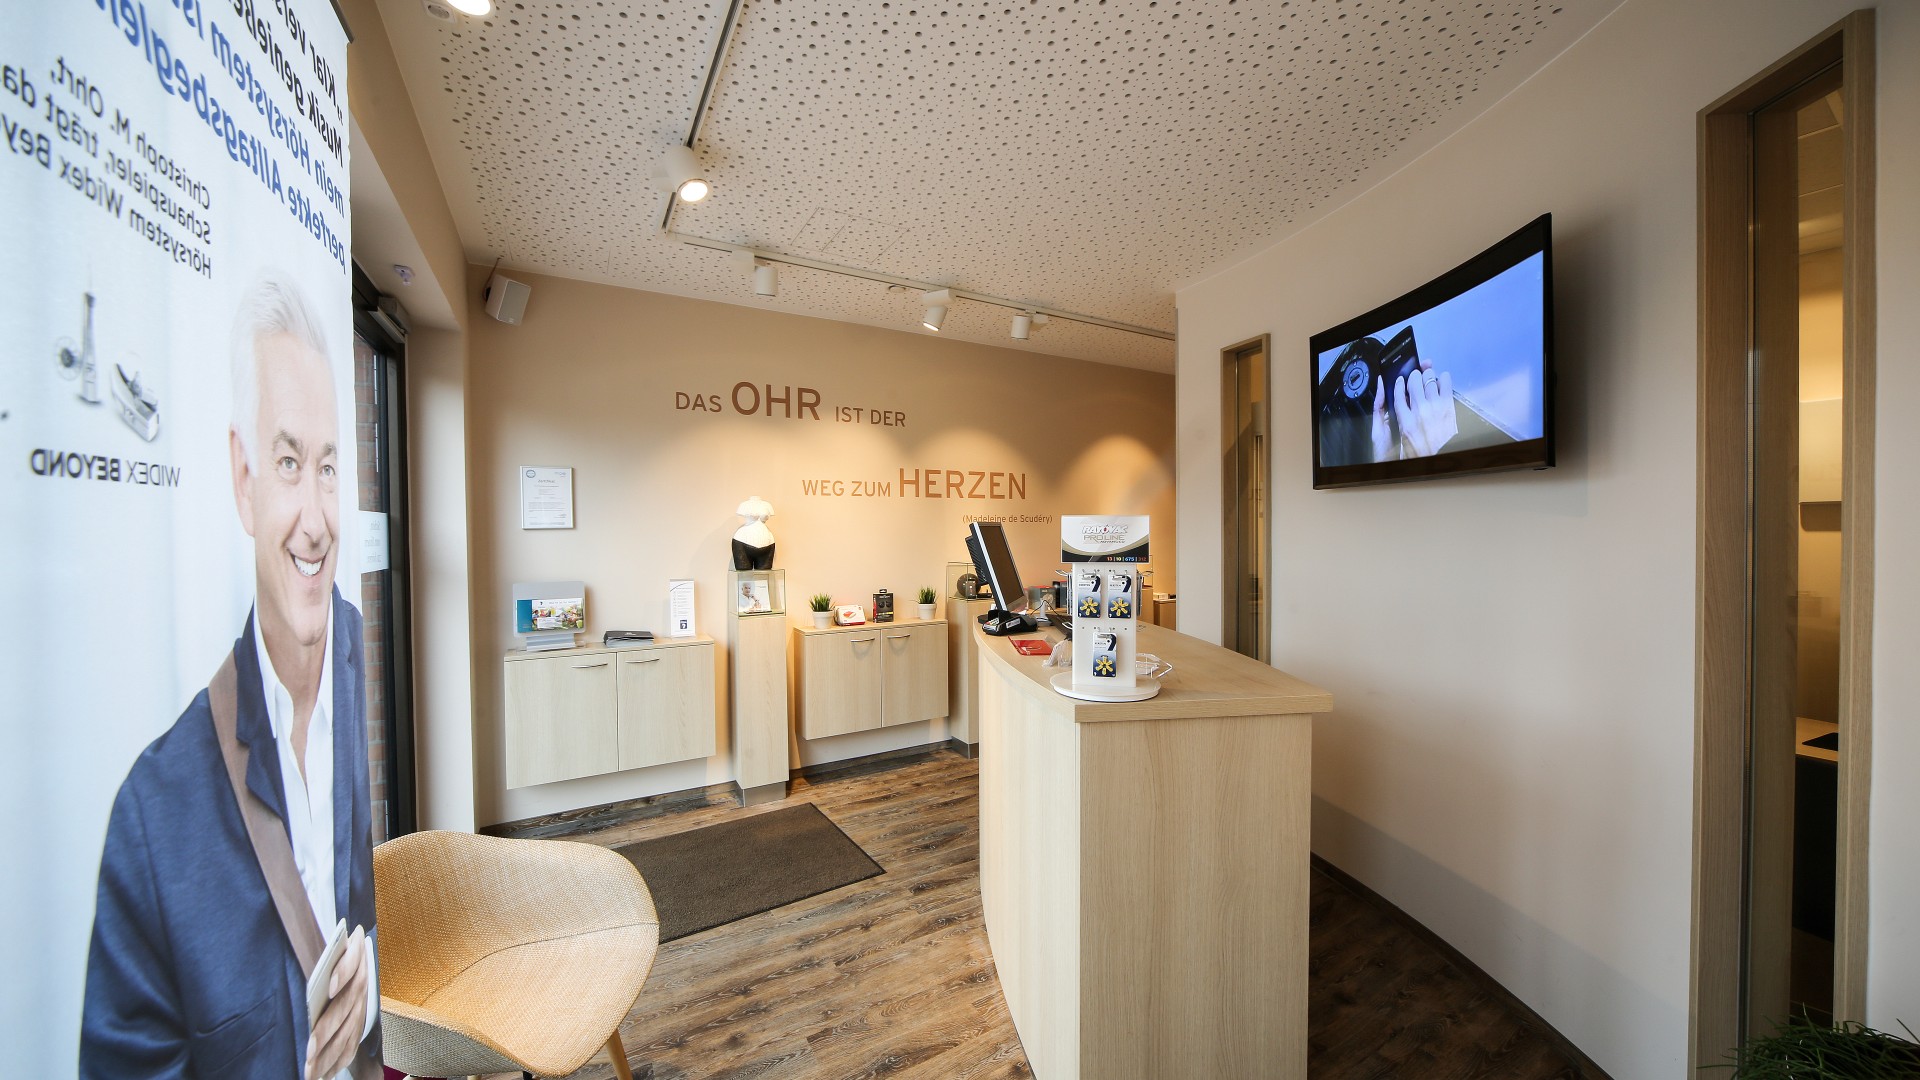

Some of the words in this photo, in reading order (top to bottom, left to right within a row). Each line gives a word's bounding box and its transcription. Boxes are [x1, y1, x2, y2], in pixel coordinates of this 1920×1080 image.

[675, 391, 723, 413] DAS
[731, 381, 821, 421] OHR
[835, 405, 864, 424] IST
[870, 408, 906, 428] DER
[801, 479, 845, 497] WEG
[850, 480, 891, 498] ZUM
[899, 467, 1026, 500] HERZEN
[962, 514, 1006, 524] (Madeleine
[1008, 514, 1018, 523] de
[1020, 514, 1053, 525] Scudéry)
